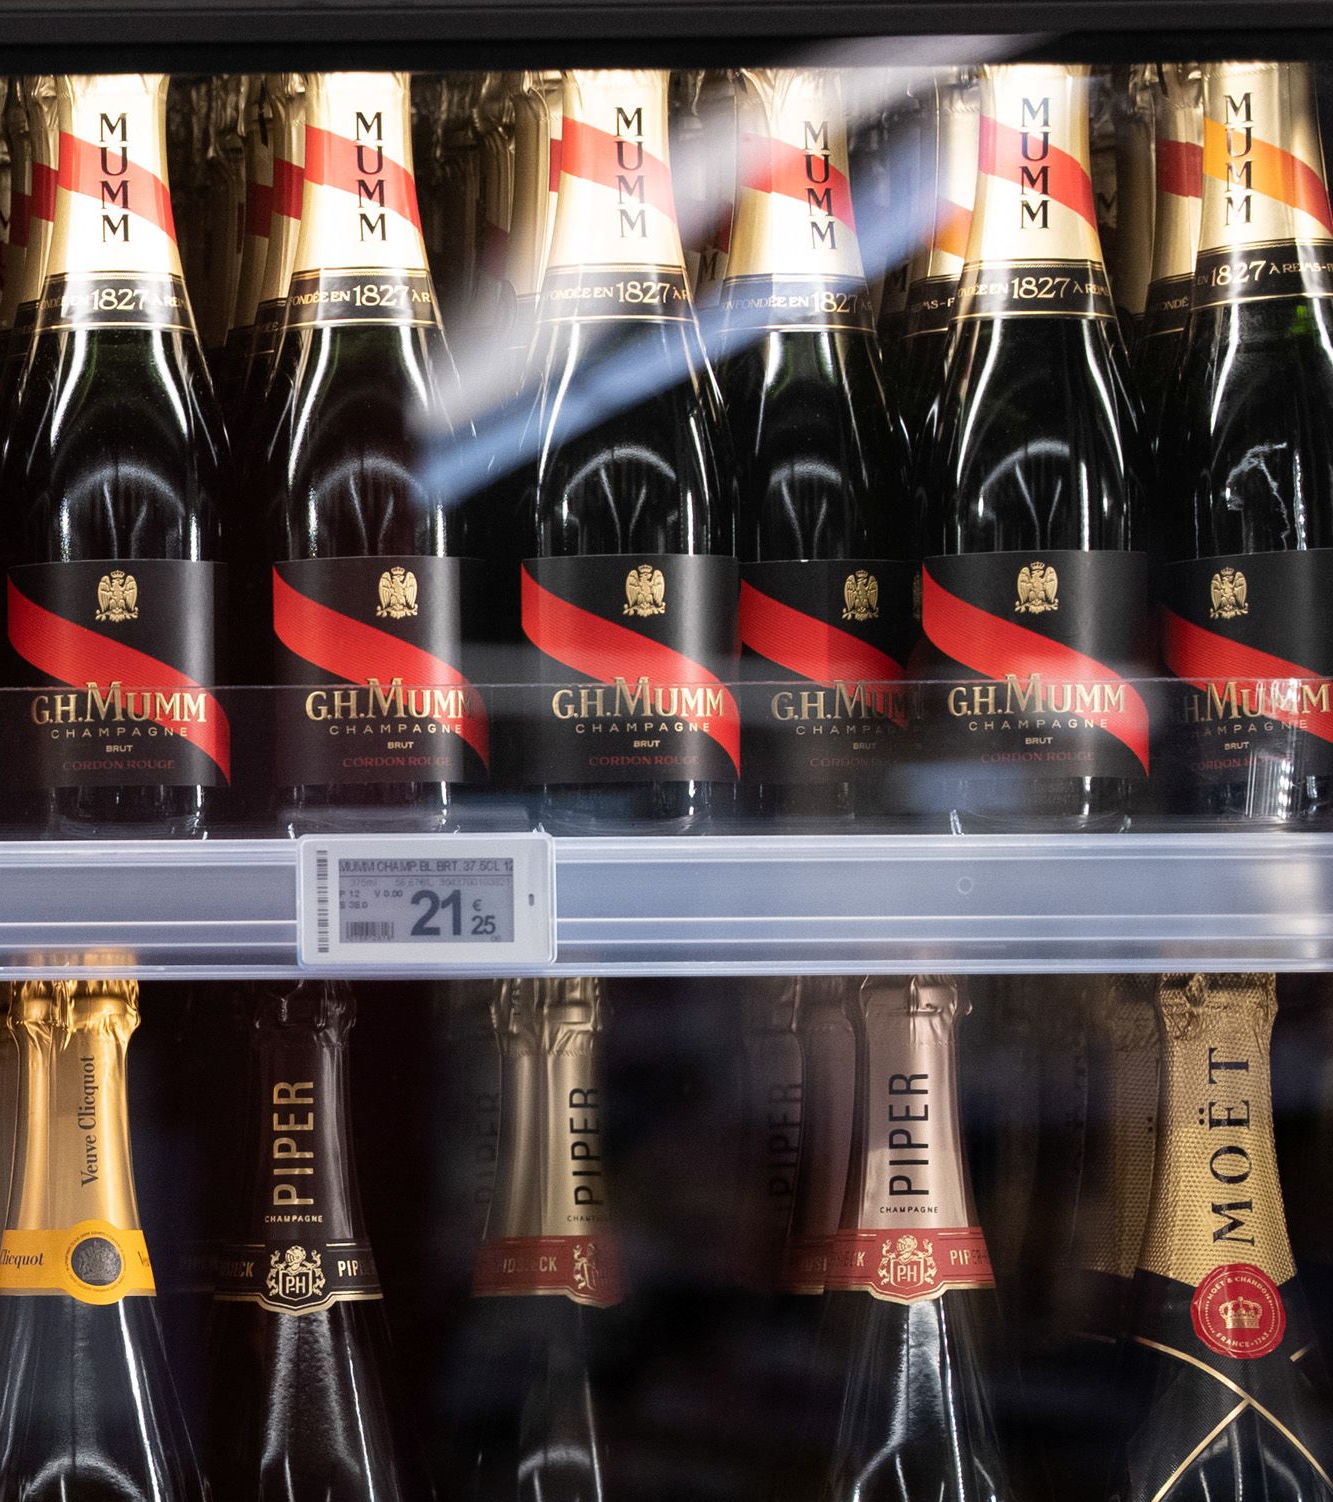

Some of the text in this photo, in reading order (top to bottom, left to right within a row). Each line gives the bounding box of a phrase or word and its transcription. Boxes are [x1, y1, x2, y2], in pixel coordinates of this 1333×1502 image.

[1021, 97, 1051, 229] MUMM
[355, 111, 387, 241] MUMM
[1211, 261, 1265, 286] 1827
[92, 289, 149, 309] 1827
[353, 284, 409, 307] 1827
[616, 281, 669, 304] 1827
[1012, 277, 1070, 298] 1827
[787, 295, 809, 307] EN
[329, 724, 462, 735] CHAMPAGNE
[576, 723, 710, 733] CHAMPAGNE
[968, 719, 1109, 730] CHAMPAGNE
[105, 745, 133, 753] BRUT
[387, 741, 414, 749] BRUT
[1025, 737, 1053, 745] BRUT
[411, 889, 496, 936] 21 25
[78, 1055, 99, 1187] Veuve Clicquot
[272, 1081, 314, 1206] PIPER
[569, 1086, 605, 1206] PIPER
[888, 1073, 929, 1197] PIPER
[1198, 1047, 1254, 1247] MOËT
